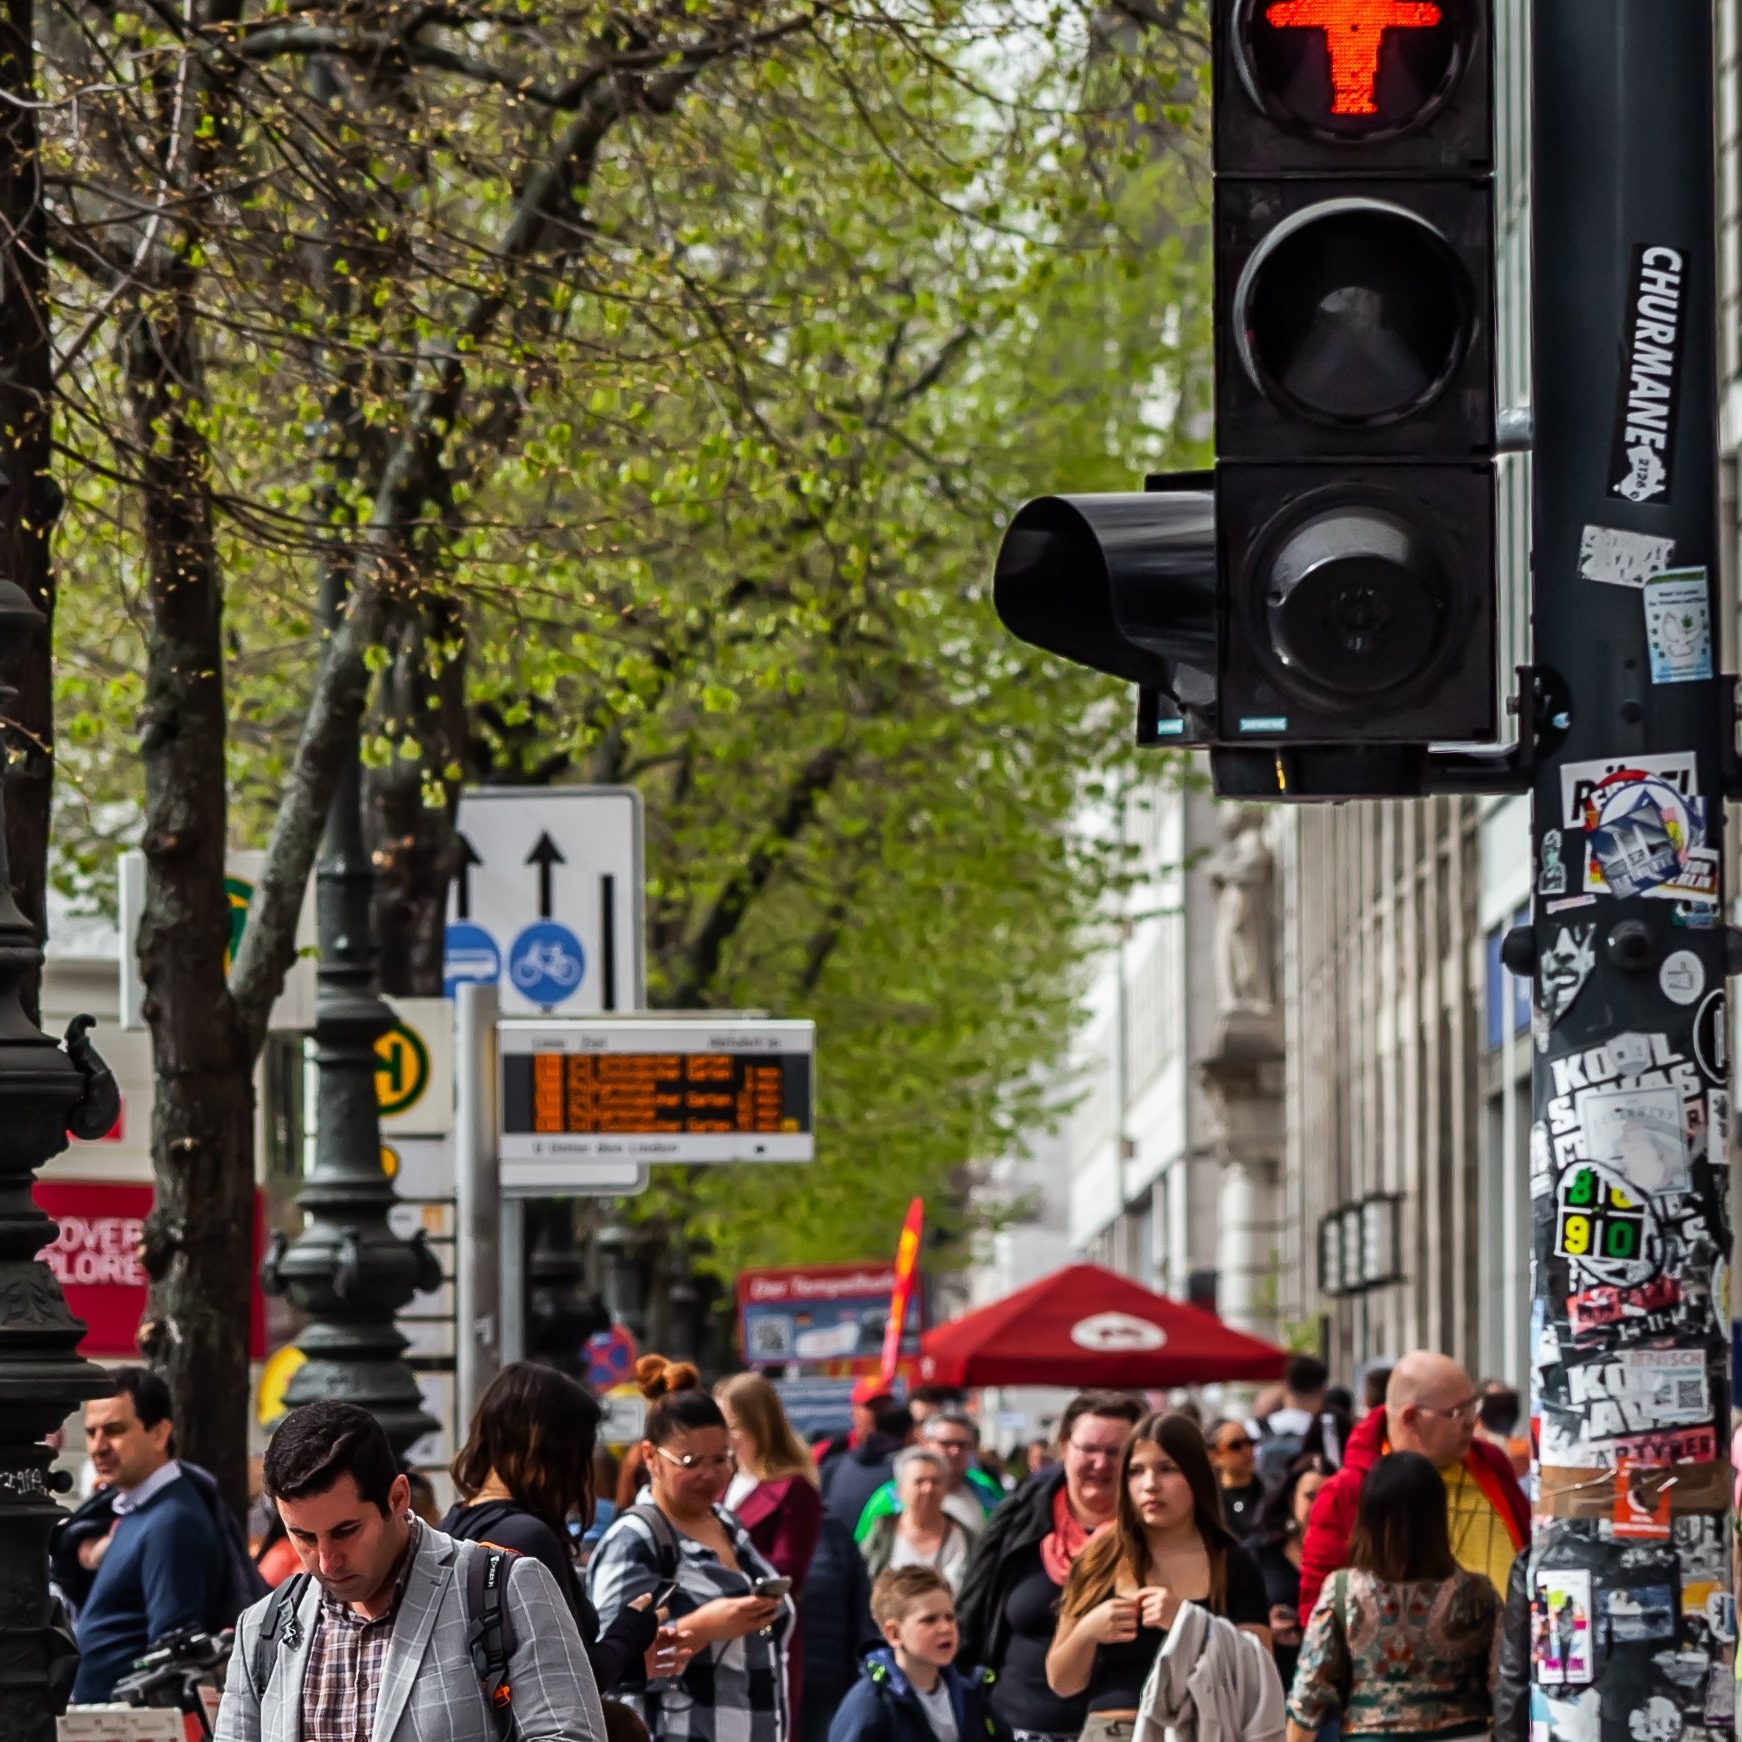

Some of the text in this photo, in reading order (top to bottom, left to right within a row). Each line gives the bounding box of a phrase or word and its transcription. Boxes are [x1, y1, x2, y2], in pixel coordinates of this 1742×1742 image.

[1624, 246, 1683, 449] CHURMANE
[1550, 1033, 1686, 1096] KOL
[54, 1217, 145, 1251] OVER
